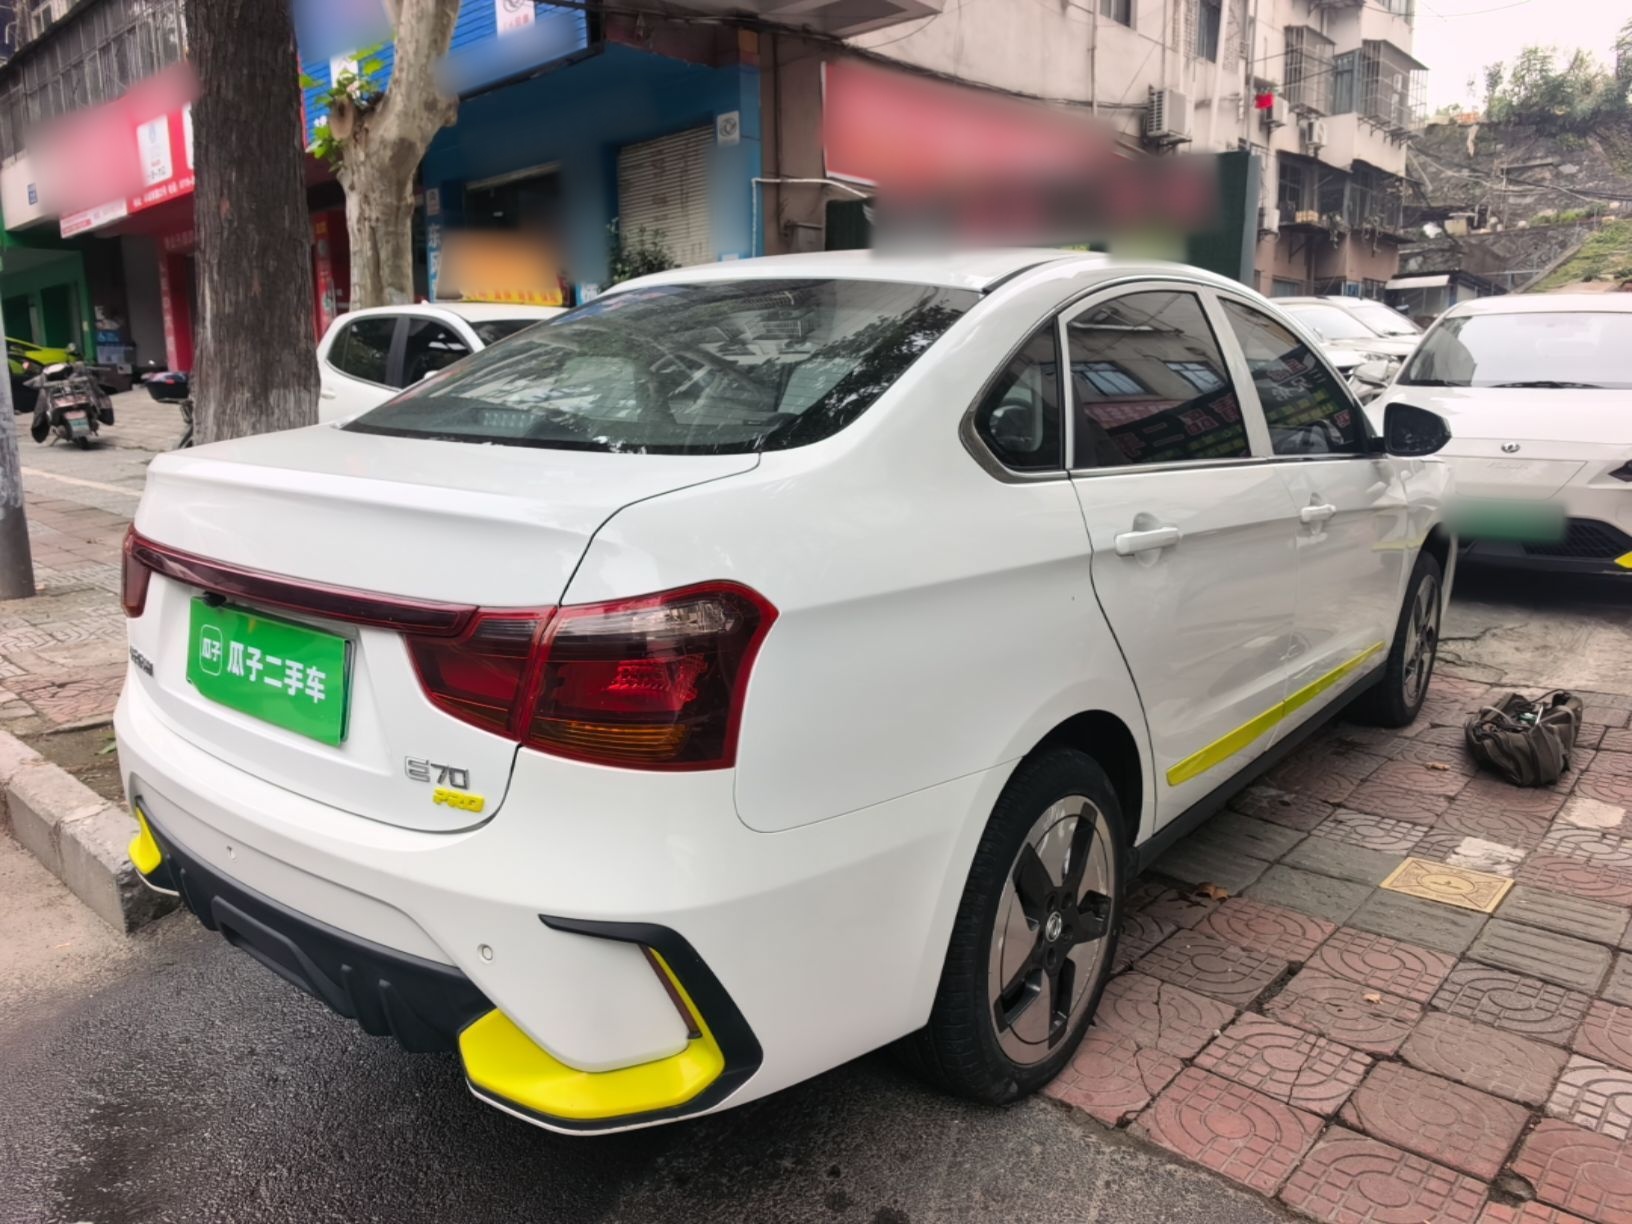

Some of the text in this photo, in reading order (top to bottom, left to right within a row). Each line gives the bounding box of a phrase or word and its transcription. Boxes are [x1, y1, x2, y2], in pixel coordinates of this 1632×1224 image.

[202, 637, 222, 662] 瓜子
[227, 640, 326, 704] 瓜子二手车
[404, 756, 470, 791] E70
[432, 787, 485, 813] PRO
